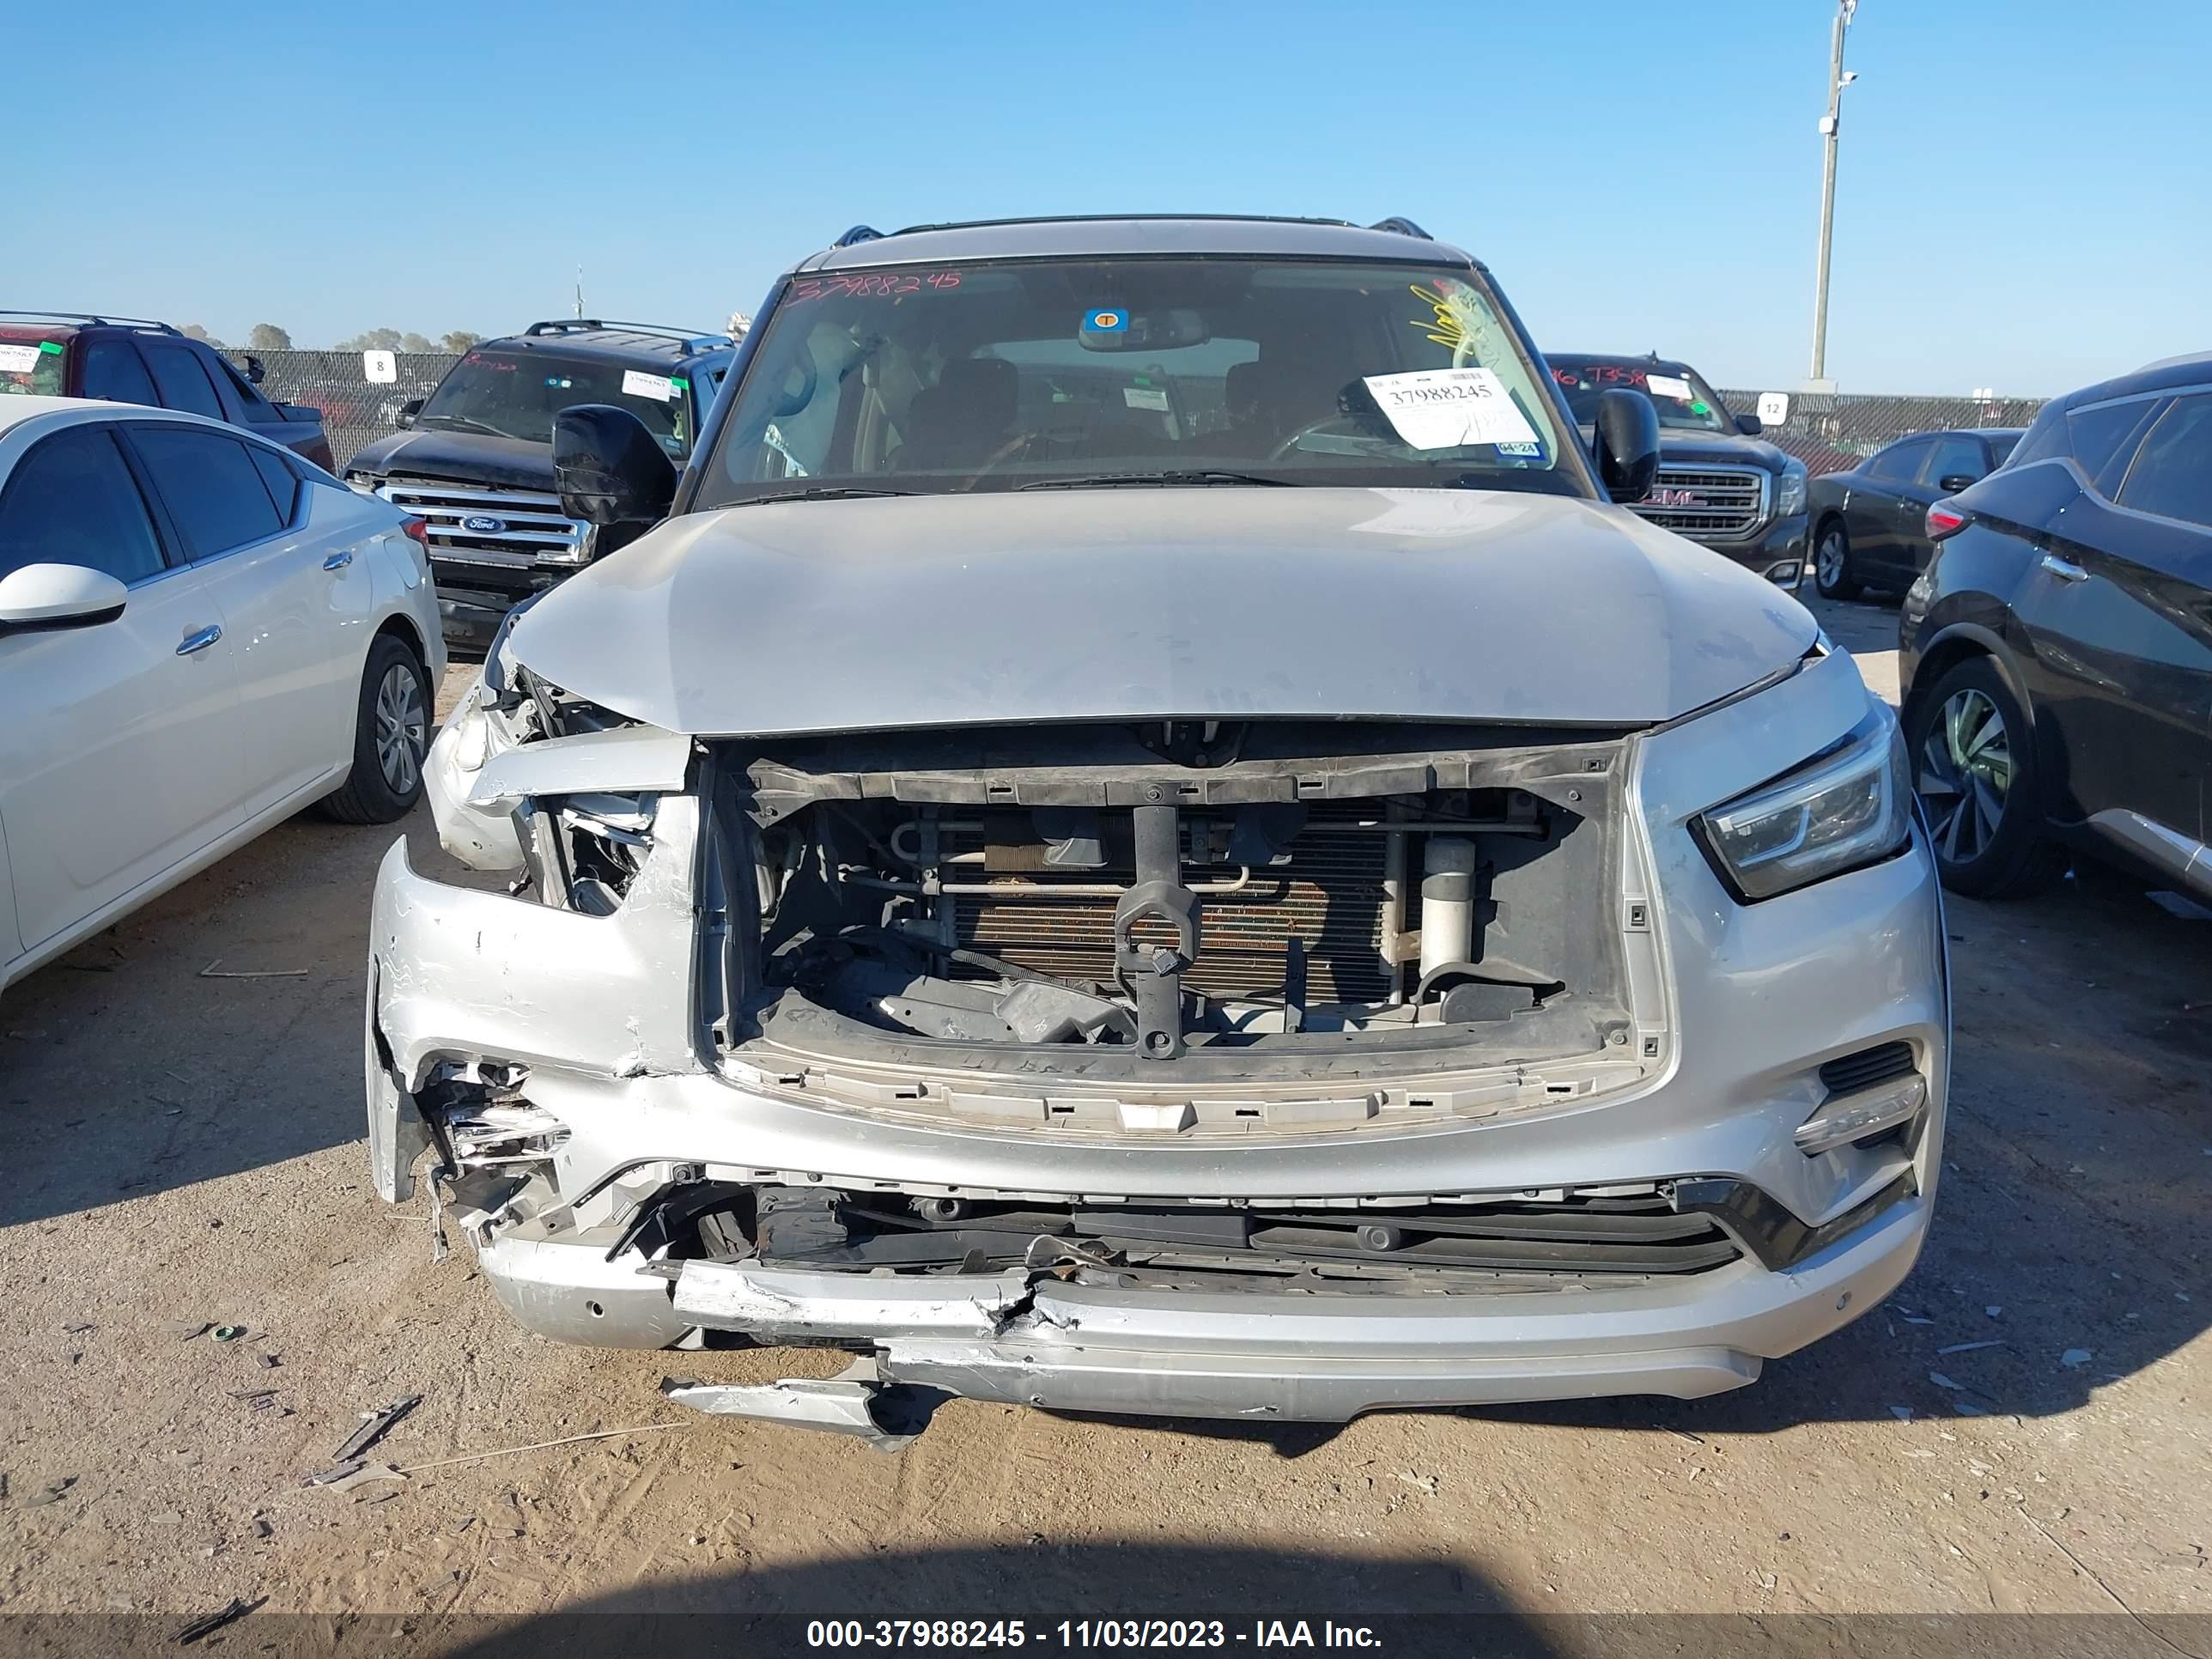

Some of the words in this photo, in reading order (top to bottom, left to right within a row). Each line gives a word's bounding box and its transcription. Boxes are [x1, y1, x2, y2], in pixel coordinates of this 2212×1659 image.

[377, 362, 385, 371] 8
[1389, 385, 1492, 405] 37988245
[1766, 404, 1780, 414] 12
[471, 518, 495, 530] Ford
